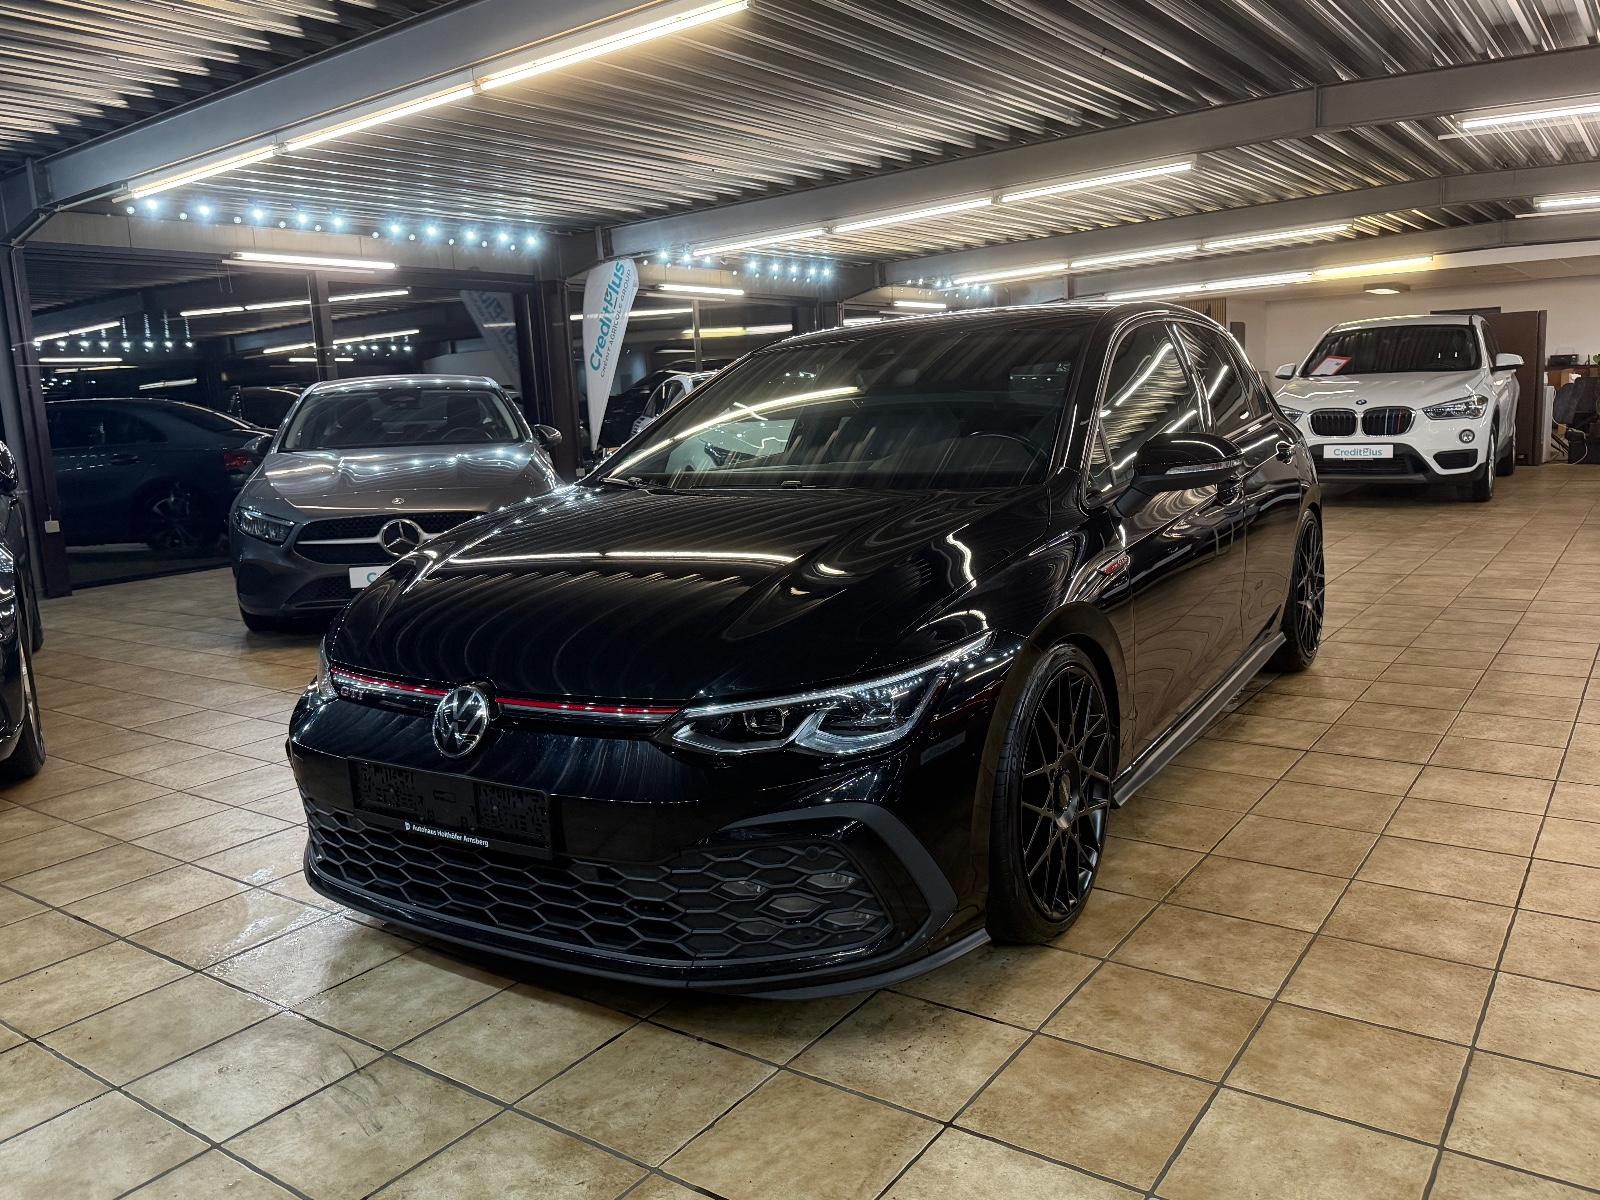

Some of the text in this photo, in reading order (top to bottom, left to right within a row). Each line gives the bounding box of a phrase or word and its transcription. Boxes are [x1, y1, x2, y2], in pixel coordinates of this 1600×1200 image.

[620, 268, 632, 302] GROUP
[589, 260, 625, 372] CreditPlus
[1333, 447, 1383, 457] CreditPlus
[412, 824, 437, 836] Autohaus
[463, 835, 489, 848] Arnsberg
